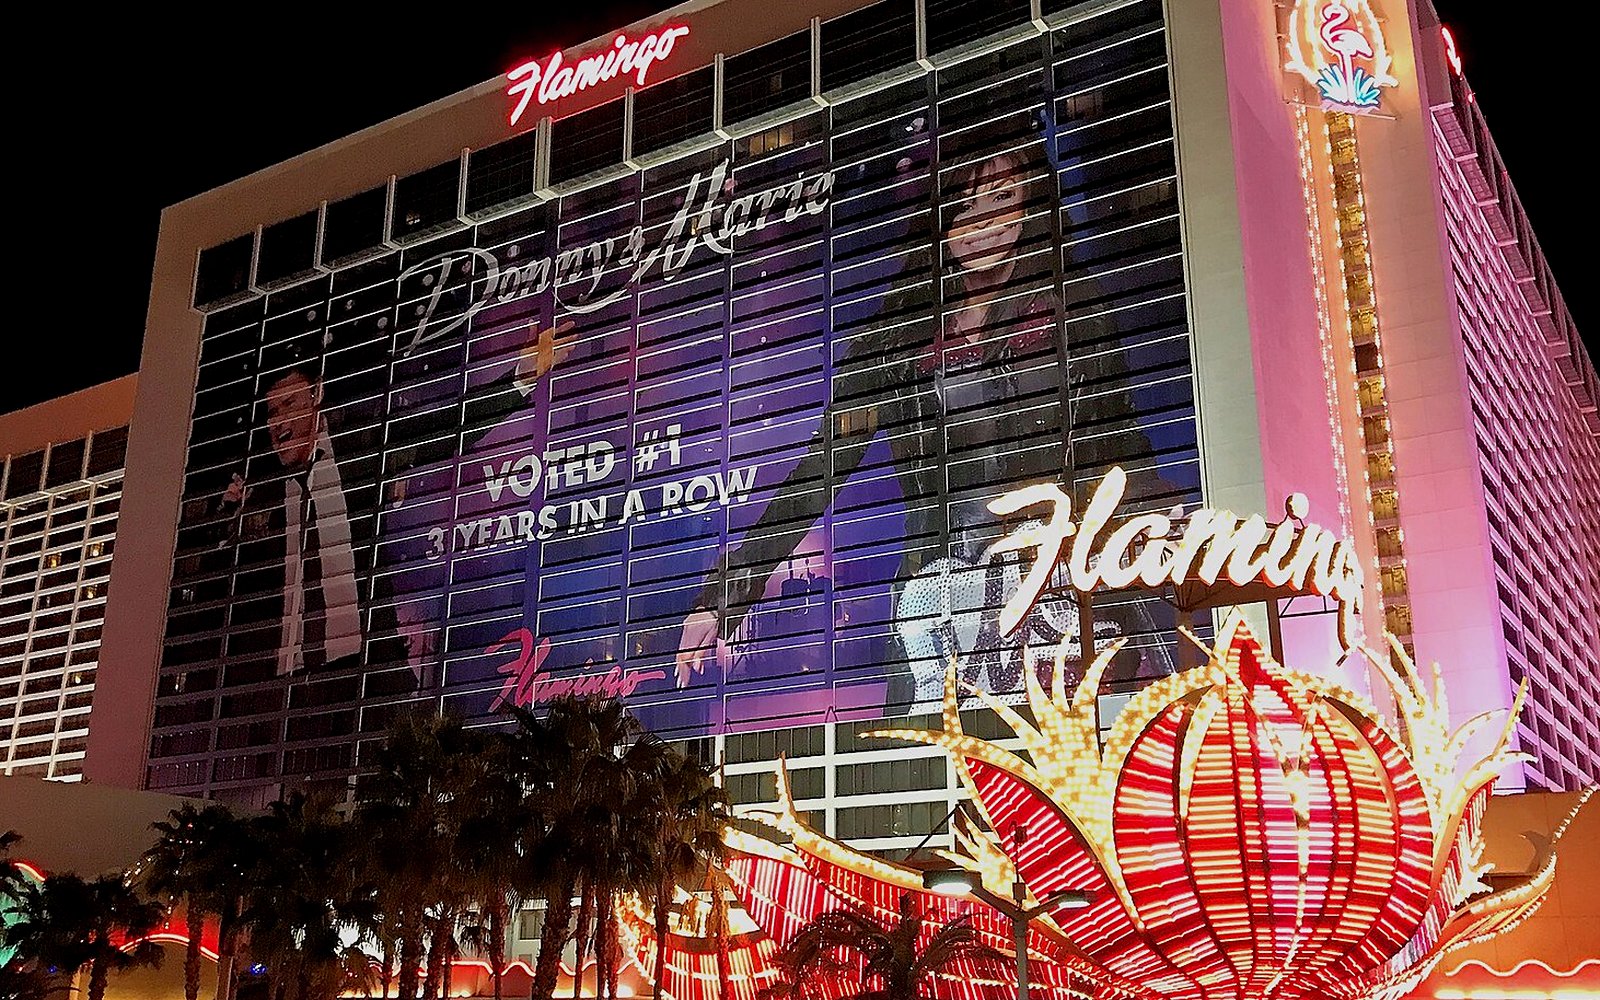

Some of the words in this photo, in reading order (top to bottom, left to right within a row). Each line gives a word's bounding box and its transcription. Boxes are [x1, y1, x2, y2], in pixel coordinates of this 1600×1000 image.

[507, 26, 690, 126] Flamingo
[397, 238, 629, 357] Donny
[632, 158, 835, 283] Marie
[482, 440, 616, 502] VOTED
[635, 423, 683, 473] #1
[425, 526, 445, 560] 3
[453, 504, 558, 555] YEARS
[566, 495, 608, 534] IN
[618, 489, 647, 524] A
[659, 465, 758, 517] ROW
[986, 466, 1365, 655] Flaming
[483, 627, 666, 714] Flamingo
